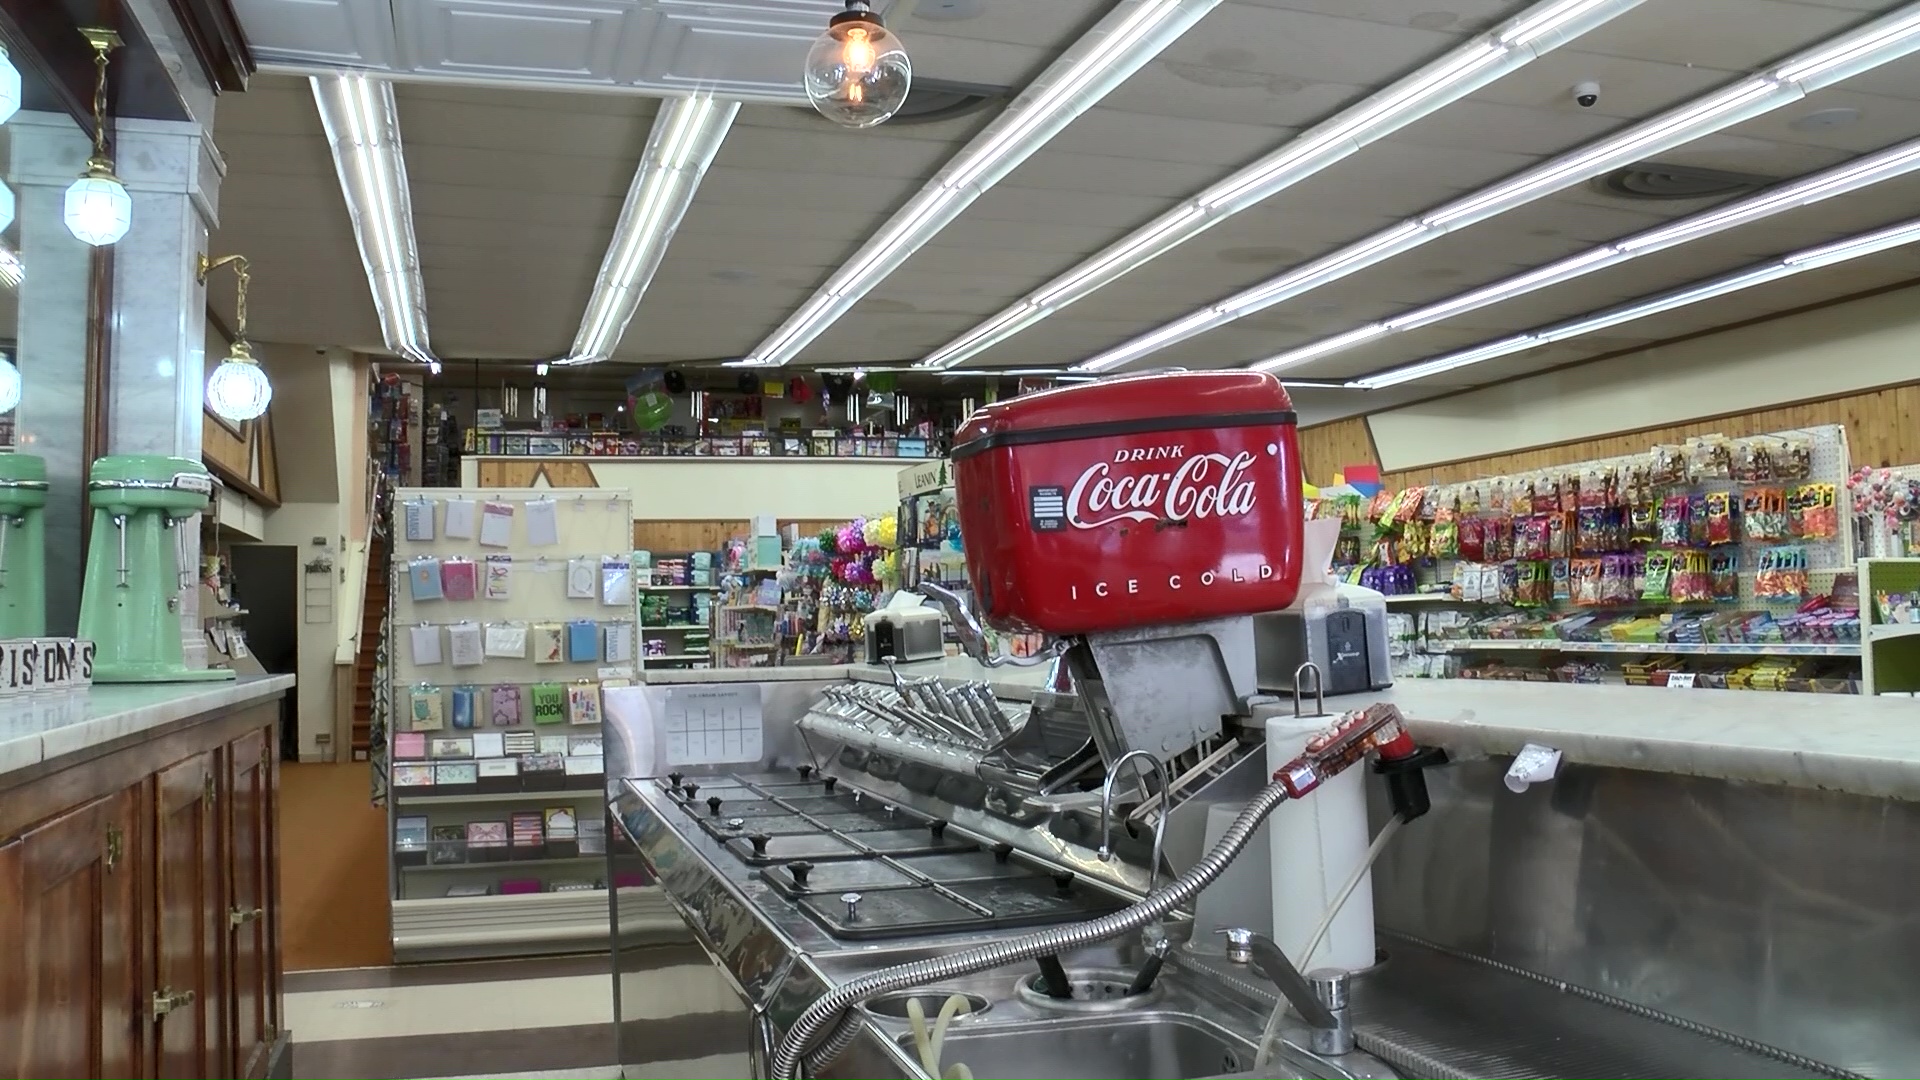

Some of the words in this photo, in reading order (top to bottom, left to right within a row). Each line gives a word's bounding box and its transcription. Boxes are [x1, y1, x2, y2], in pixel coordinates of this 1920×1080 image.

[1114, 445, 1185, 463] DRINK
[1066, 451, 1258, 529] Coca-Cola
[1072, 579, 1138, 600] ICE
[1169, 565, 1273, 589] COLD
[539, 694, 559, 704] YOU
[535, 703, 563, 717] ROCK
